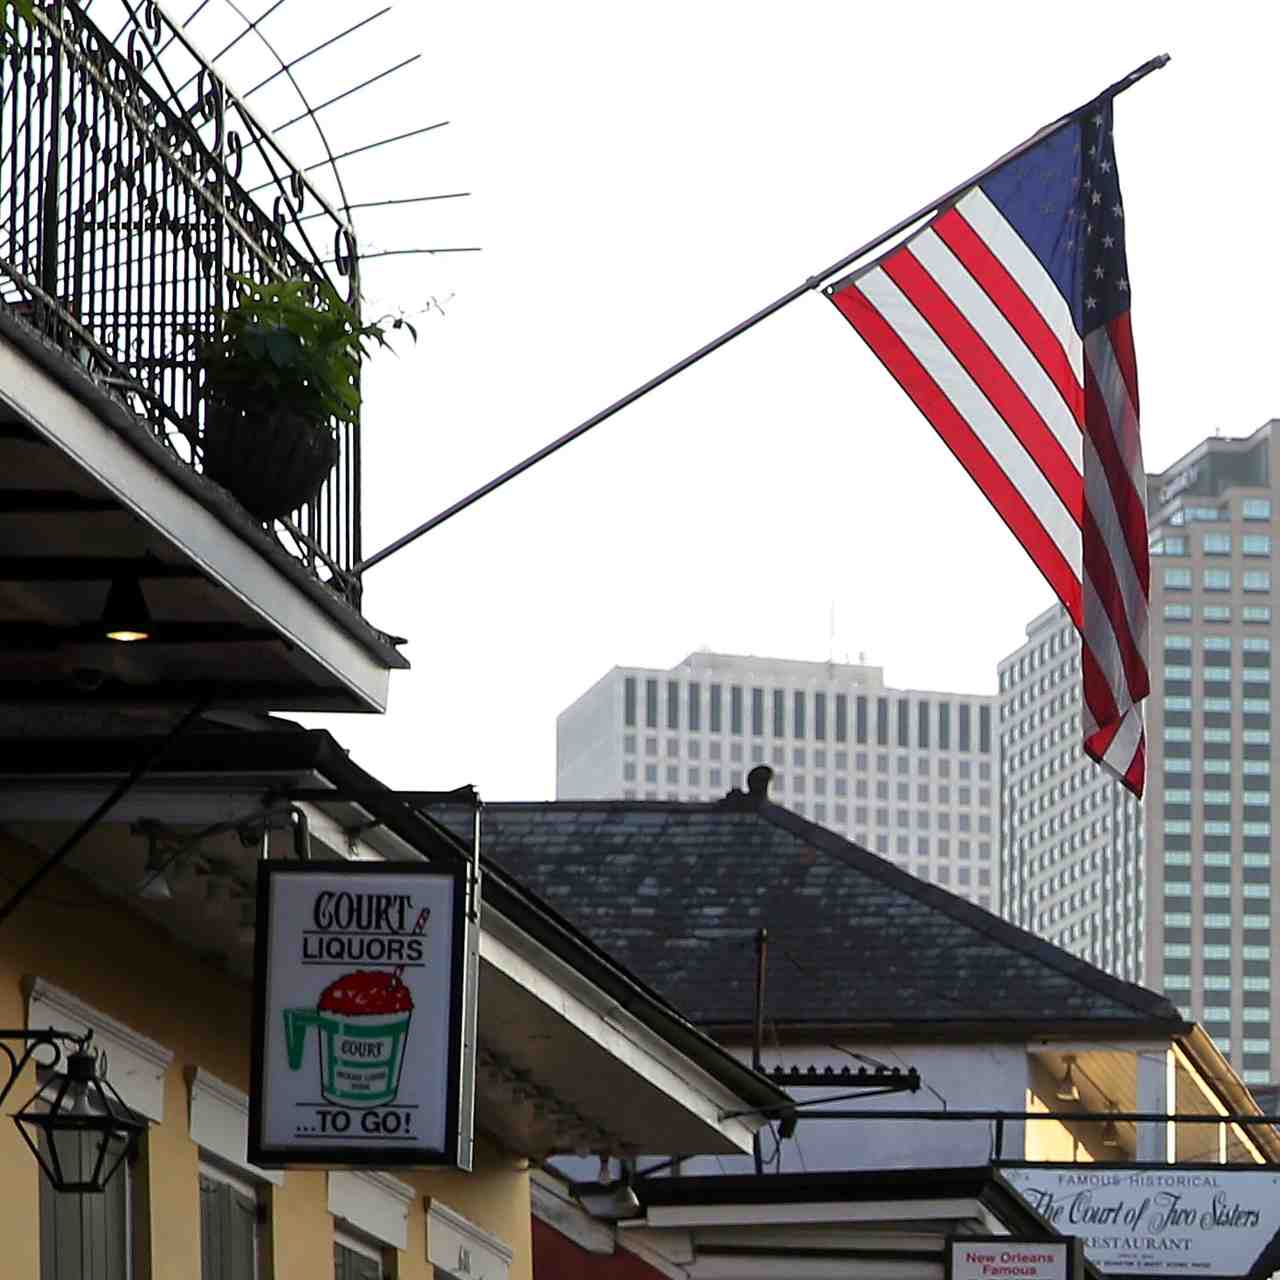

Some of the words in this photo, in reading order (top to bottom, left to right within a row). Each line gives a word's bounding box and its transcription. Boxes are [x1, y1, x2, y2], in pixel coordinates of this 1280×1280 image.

[314, 891, 414, 933] COURT
[303, 937, 423, 960] LIQUORS
[361, 1111, 411, 1133] GO!
[1058, 1175, 1120, 1187] FAMOUS
[1129, 1176, 1220, 1188] HISTORICAL
[1024, 1187, 1063, 1224] The
[1069, 1189, 1123, 1226] Court
[1124, 1196, 1151, 1230] of
[1147, 1190, 1197, 1234] Two
[1198, 1190, 1261, 1231] Sisters
[966, 1252, 996, 1263] New
[1001, 1251, 1055, 1263] Orleans
[982, 1265, 1037, 1275] Famous
